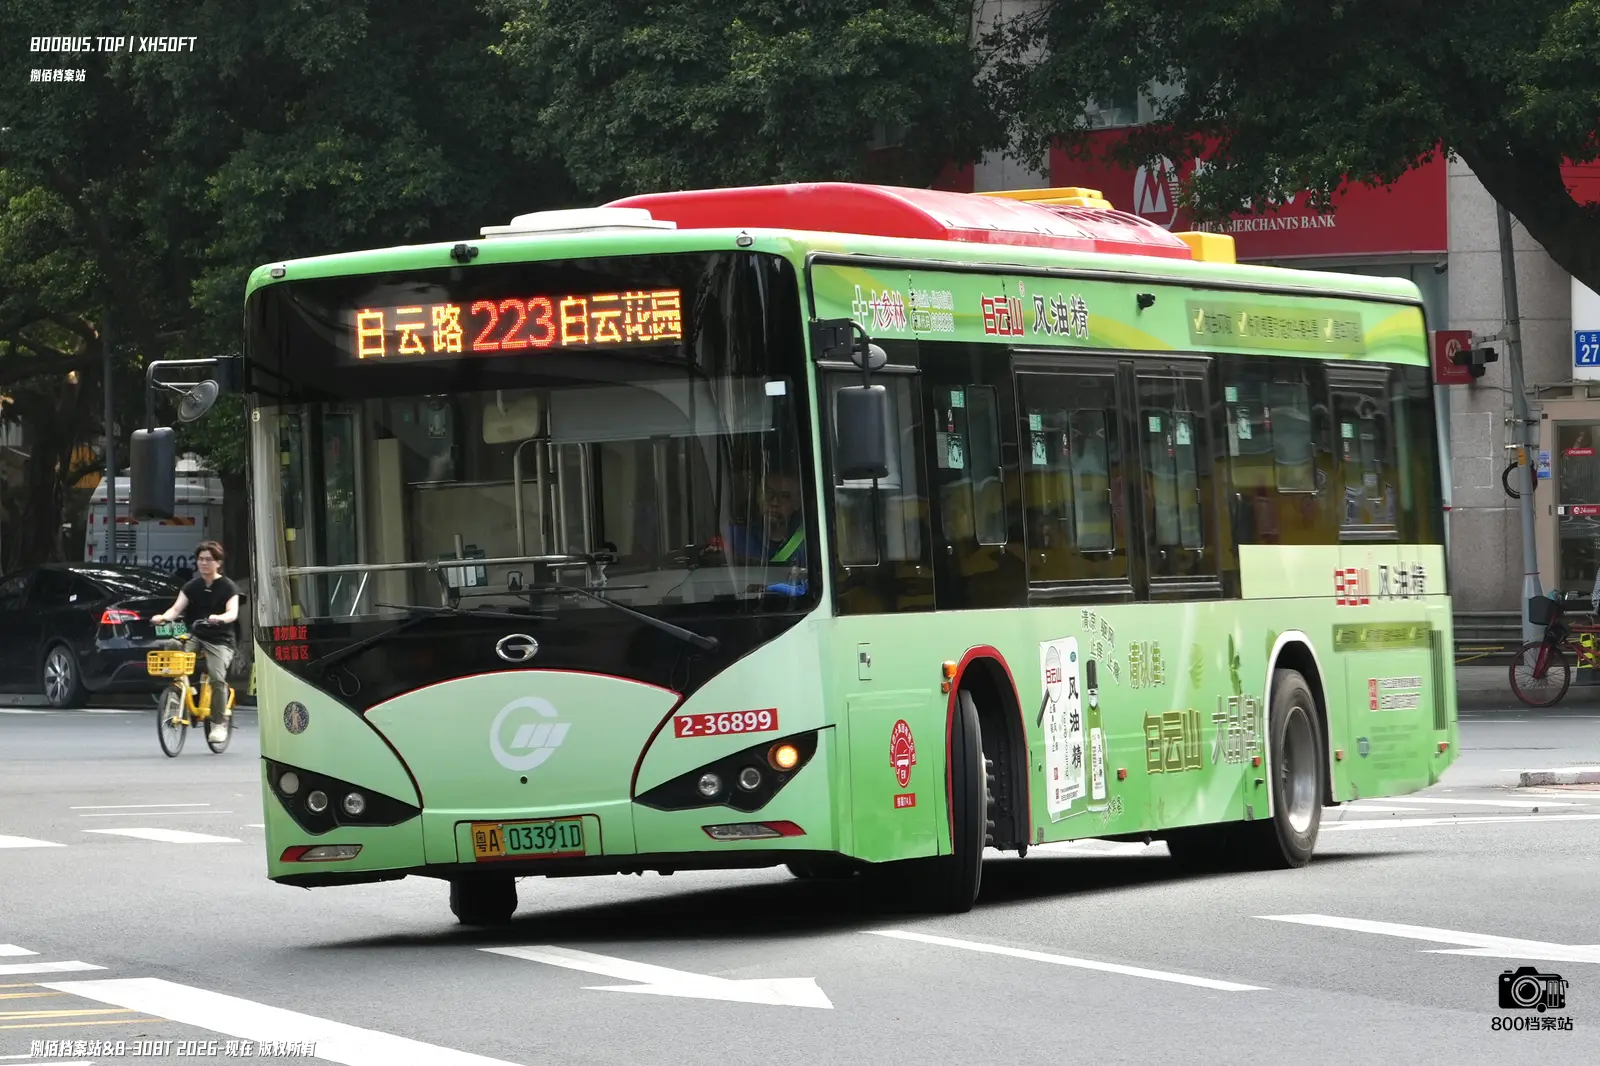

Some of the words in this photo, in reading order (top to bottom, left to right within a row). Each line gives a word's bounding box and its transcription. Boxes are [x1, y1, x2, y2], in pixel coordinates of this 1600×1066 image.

[1301, 214, 1336, 229] BANK
[356, 303, 463, 358] 白云路
[471, 297, 555, 351] 223
[560, 288, 682, 346] 白云花园
[869, 289, 907, 332] 大参林
[980, 292, 1025, 337] 白云山
[1032, 294, 1089, 340] 风油精
[1335, 567, 1371, 606] 白云山
[680, 710, 772, 736] 2-36899
[1143, 707, 1203, 774] 白云山
[1211, 693, 1262, 764] 大品牌
[475, 829, 500, 852] 粤A
[509, 823, 582, 851] 03391D
